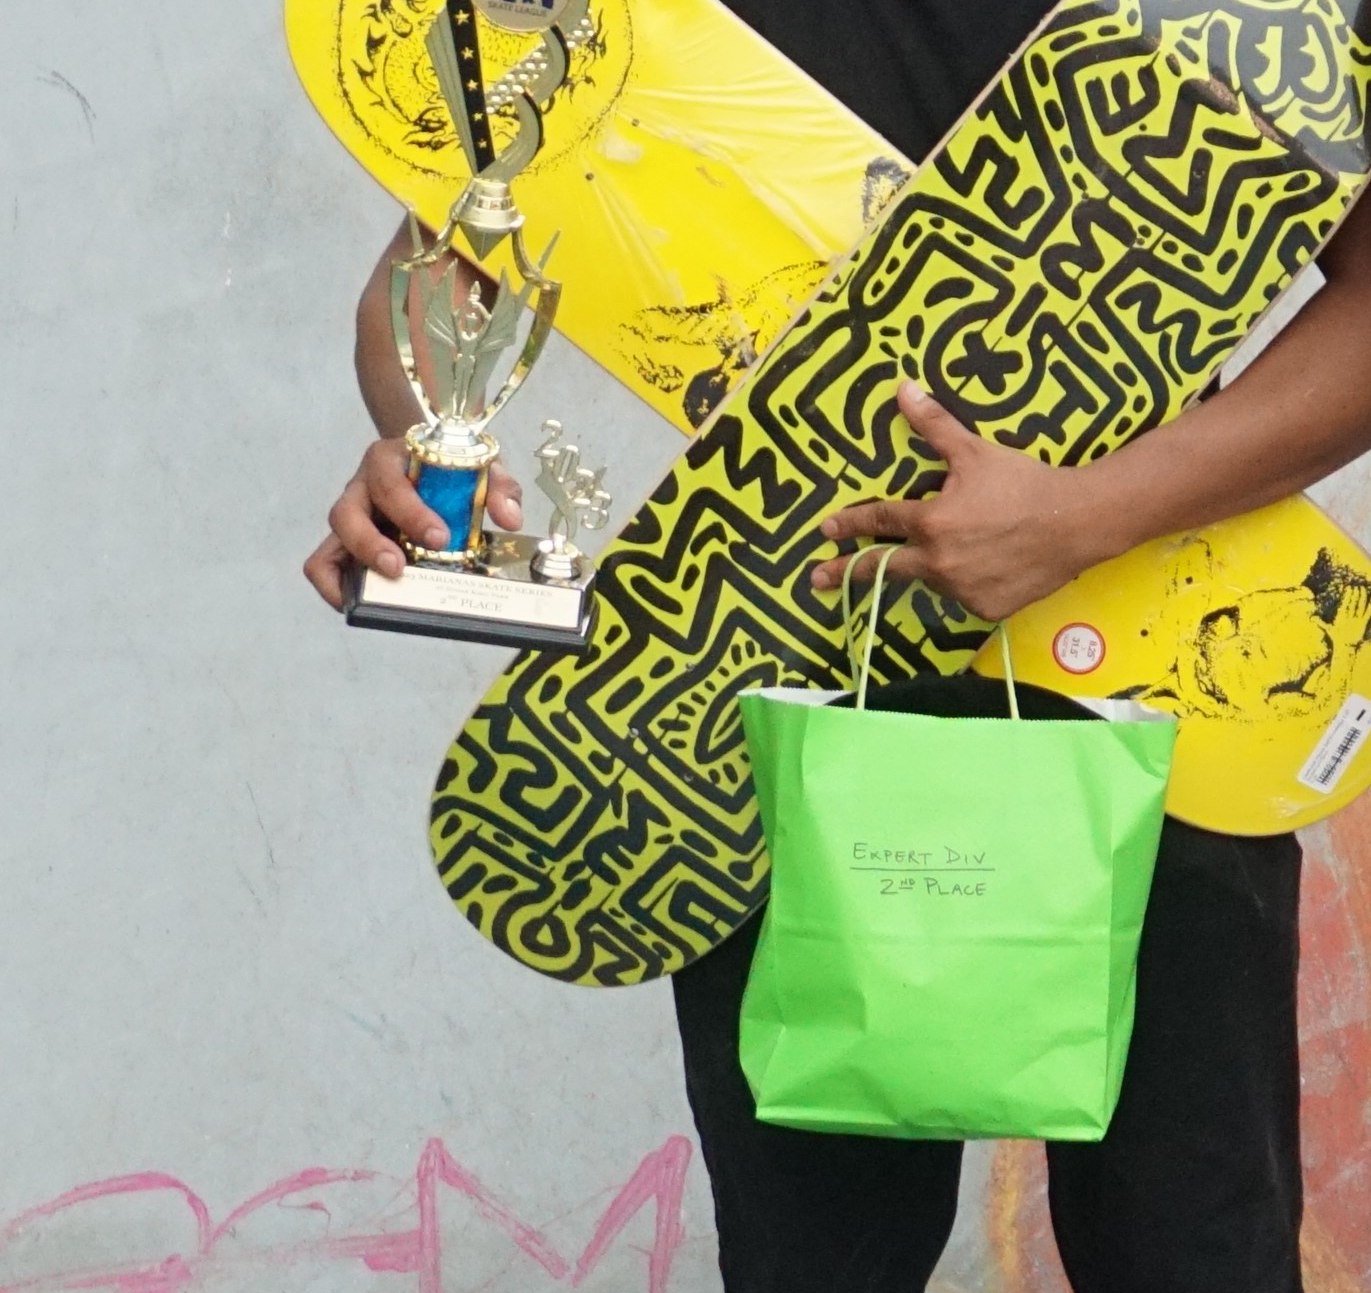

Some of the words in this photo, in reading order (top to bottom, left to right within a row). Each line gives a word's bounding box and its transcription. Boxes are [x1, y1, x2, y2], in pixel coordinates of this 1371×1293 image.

[418, 573, 476, 588] MARIANAS
[478, 581, 512, 593] SKATE
[514, 586, 553, 598] SERIES
[461, 596, 503, 612] PLACE
[852, 842, 933, 865] EXPERT
[945, 845, 987, 865] DIV
[926, 876, 988, 897] PLACE
